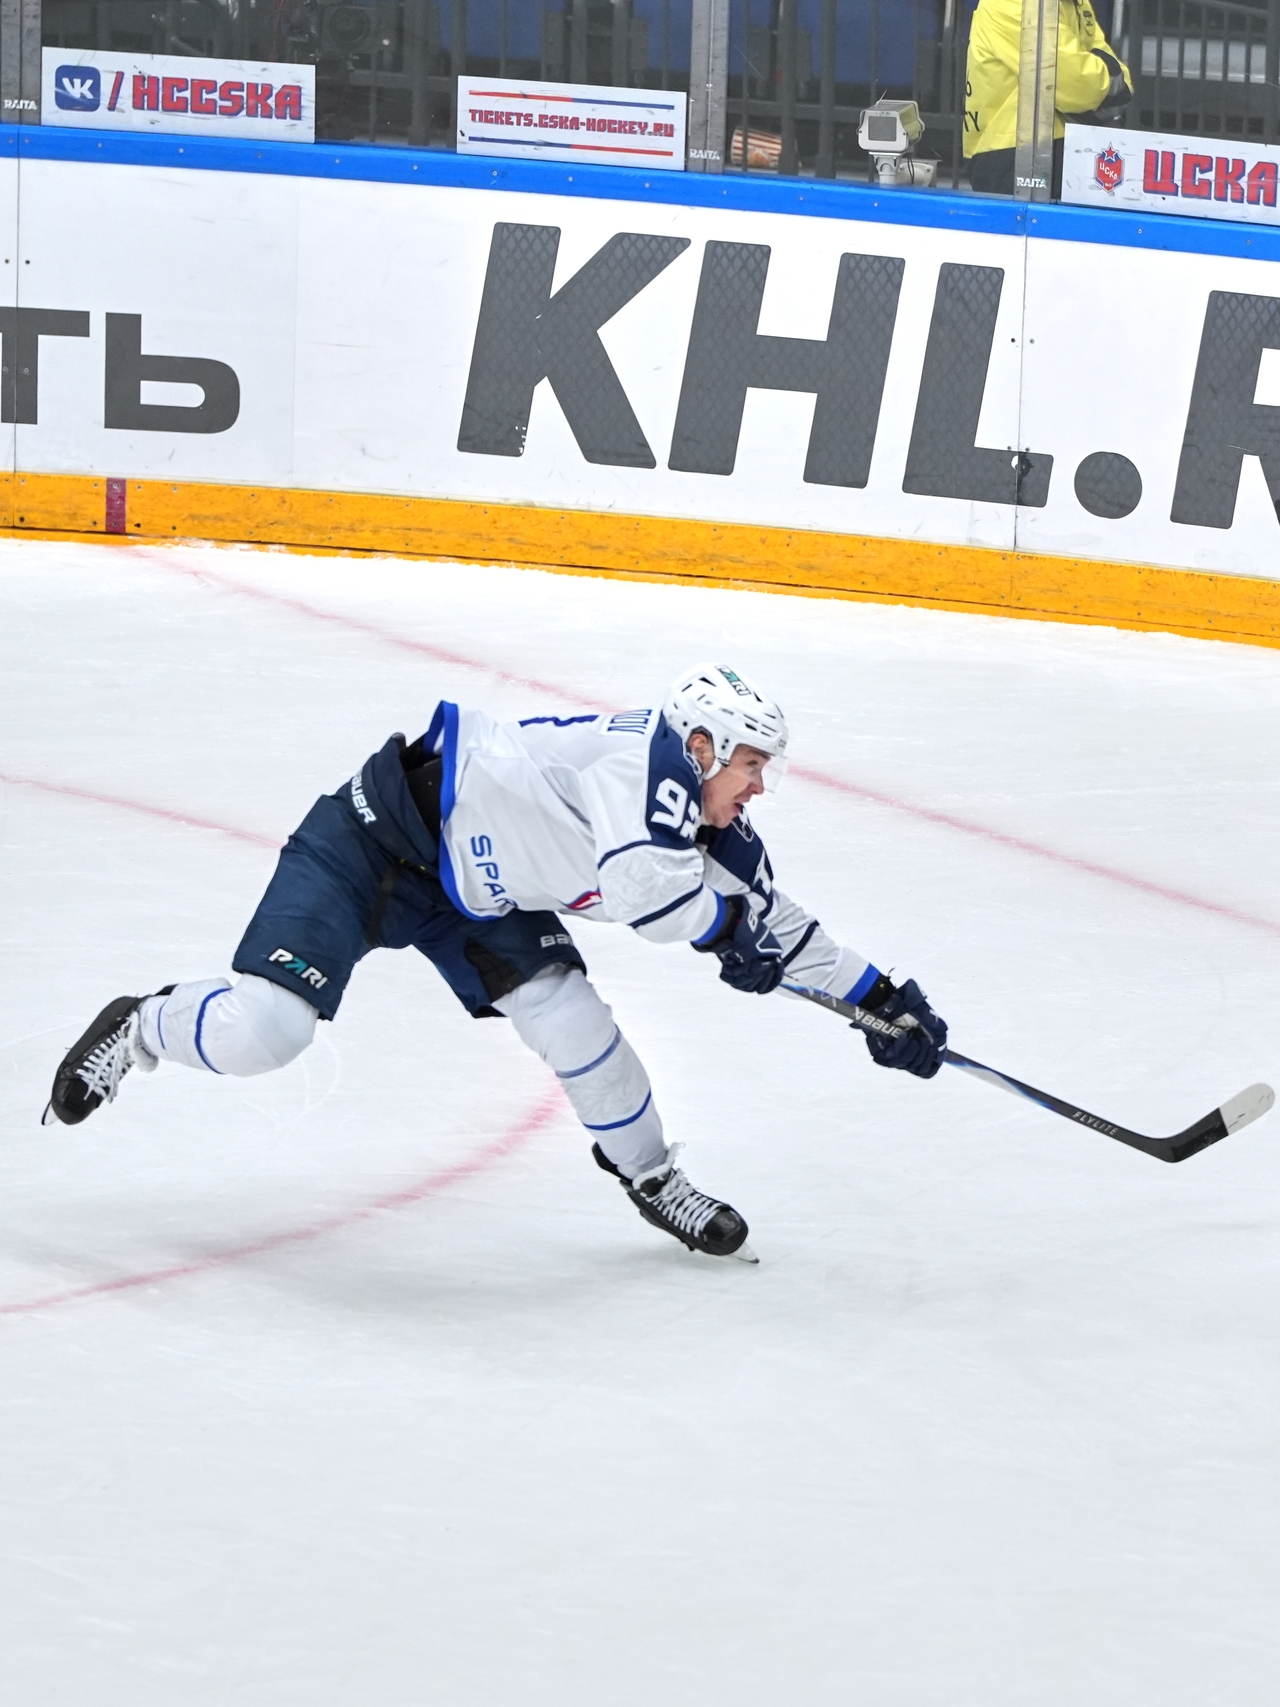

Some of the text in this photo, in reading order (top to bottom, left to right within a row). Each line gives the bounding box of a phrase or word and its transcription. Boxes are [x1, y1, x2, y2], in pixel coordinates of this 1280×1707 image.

[468, 108, 675, 138] TICKETS.CSKA-HOCKEY.RU
[1016, 176, 1047, 189] RAITA
[1143, 149, 1279, 208] ЦСКА
[1072, 1111, 1119, 1135] FLYLITE
